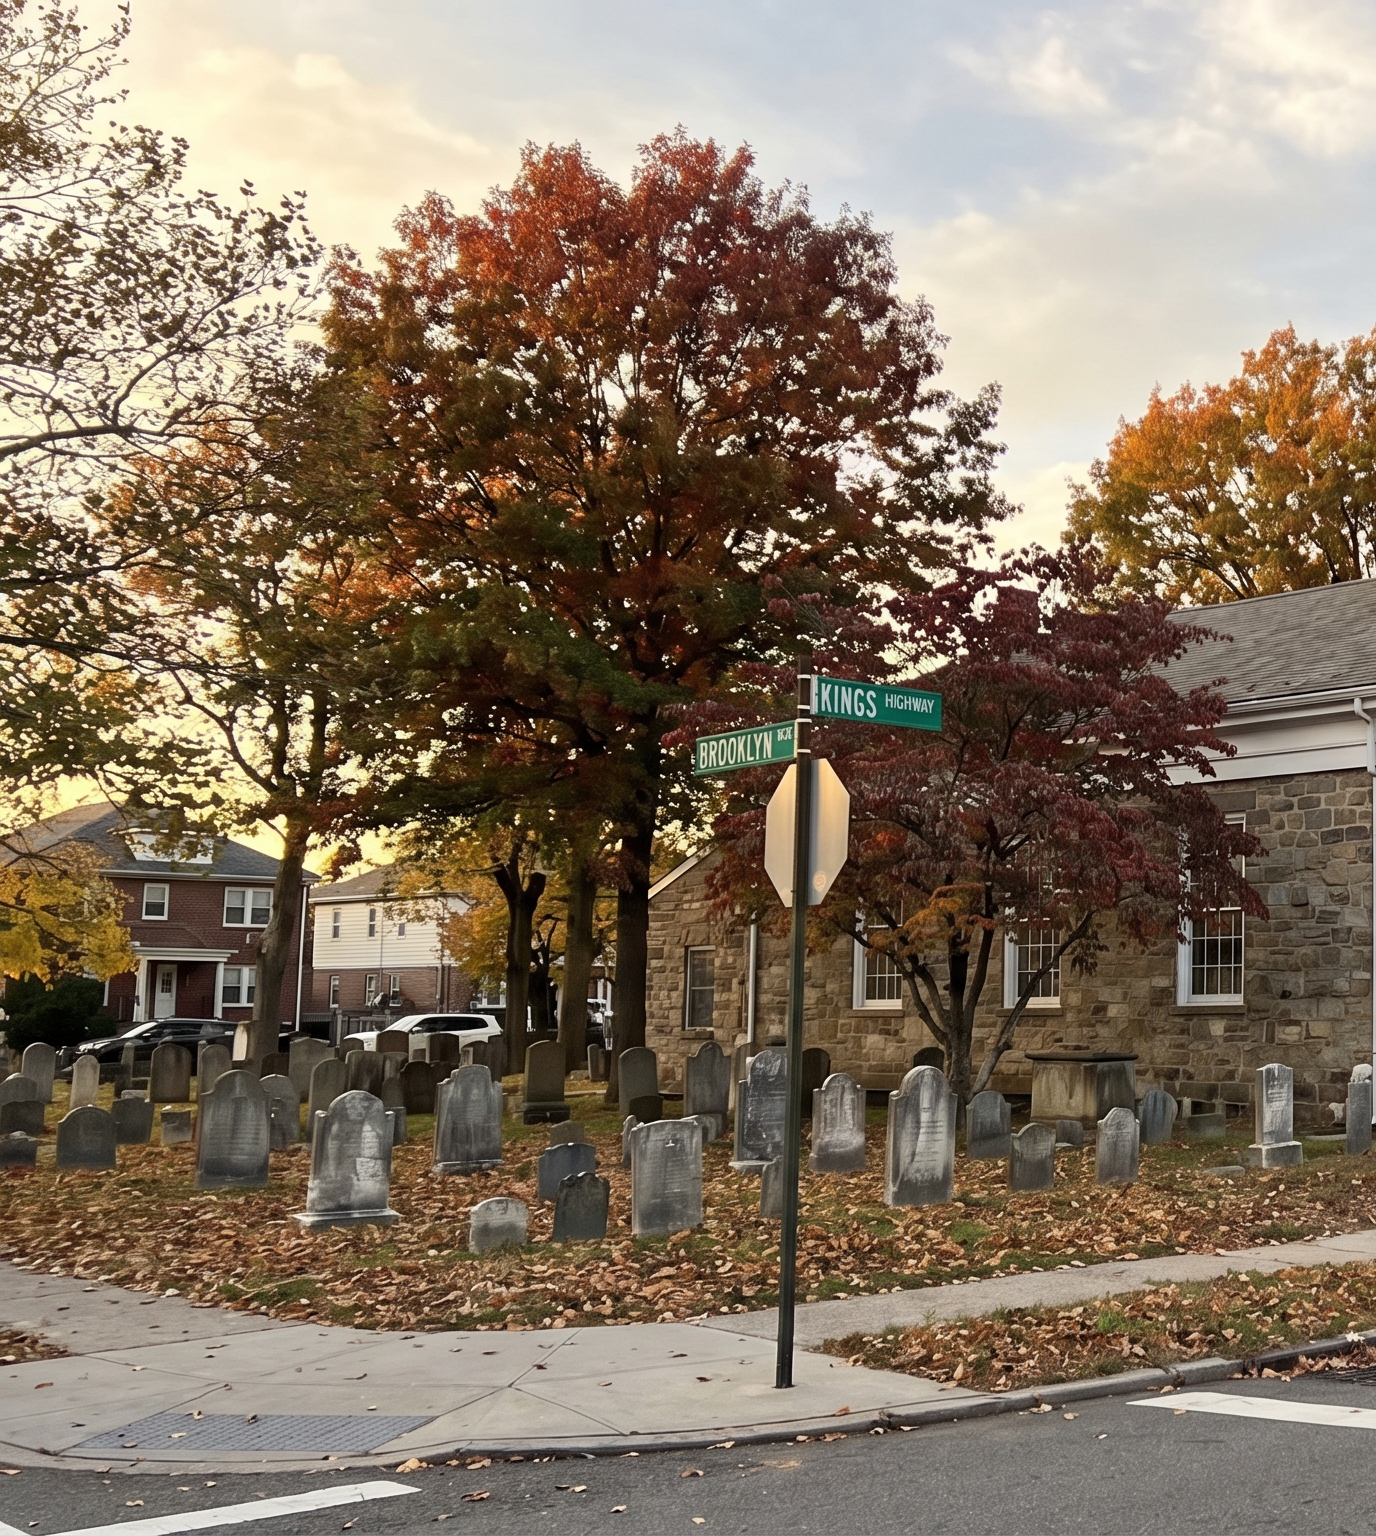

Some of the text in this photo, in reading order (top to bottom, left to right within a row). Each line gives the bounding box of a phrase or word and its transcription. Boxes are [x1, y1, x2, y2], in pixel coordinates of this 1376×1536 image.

[821, 683, 935, 718] KINGS HIGHWAY
[699, 730, 772, 769] BROOKLYN
